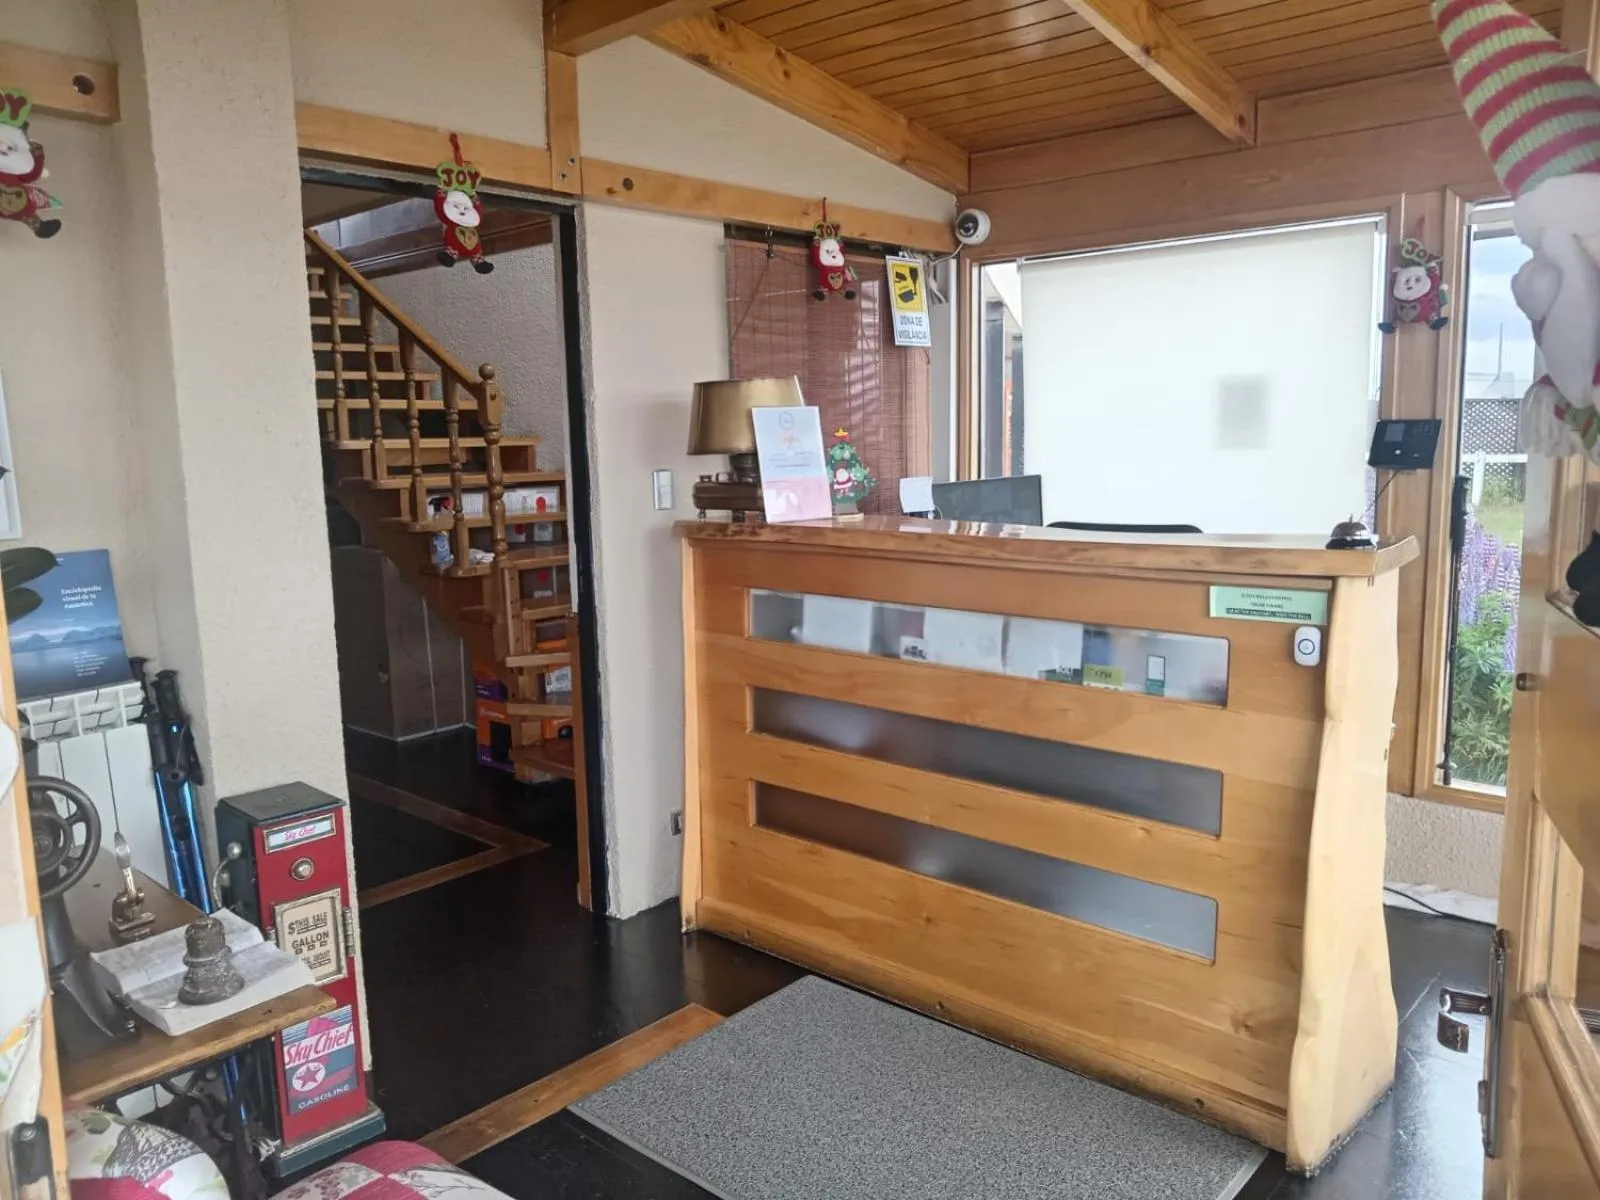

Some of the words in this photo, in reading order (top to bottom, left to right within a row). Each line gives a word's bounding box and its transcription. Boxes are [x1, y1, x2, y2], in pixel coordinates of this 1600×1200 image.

[441, 168, 480, 190] JOY
[816, 223, 840, 237] JOY
[1405, 240, 1441, 263] JOY
[312, 911, 328, 924] SALE
[292, 931, 329, 949] GALLON
[285, 1042, 312, 1066] Sky
[314, 1023, 354, 1054] Chief
[298, 1083, 351, 1110] GASOLINE
